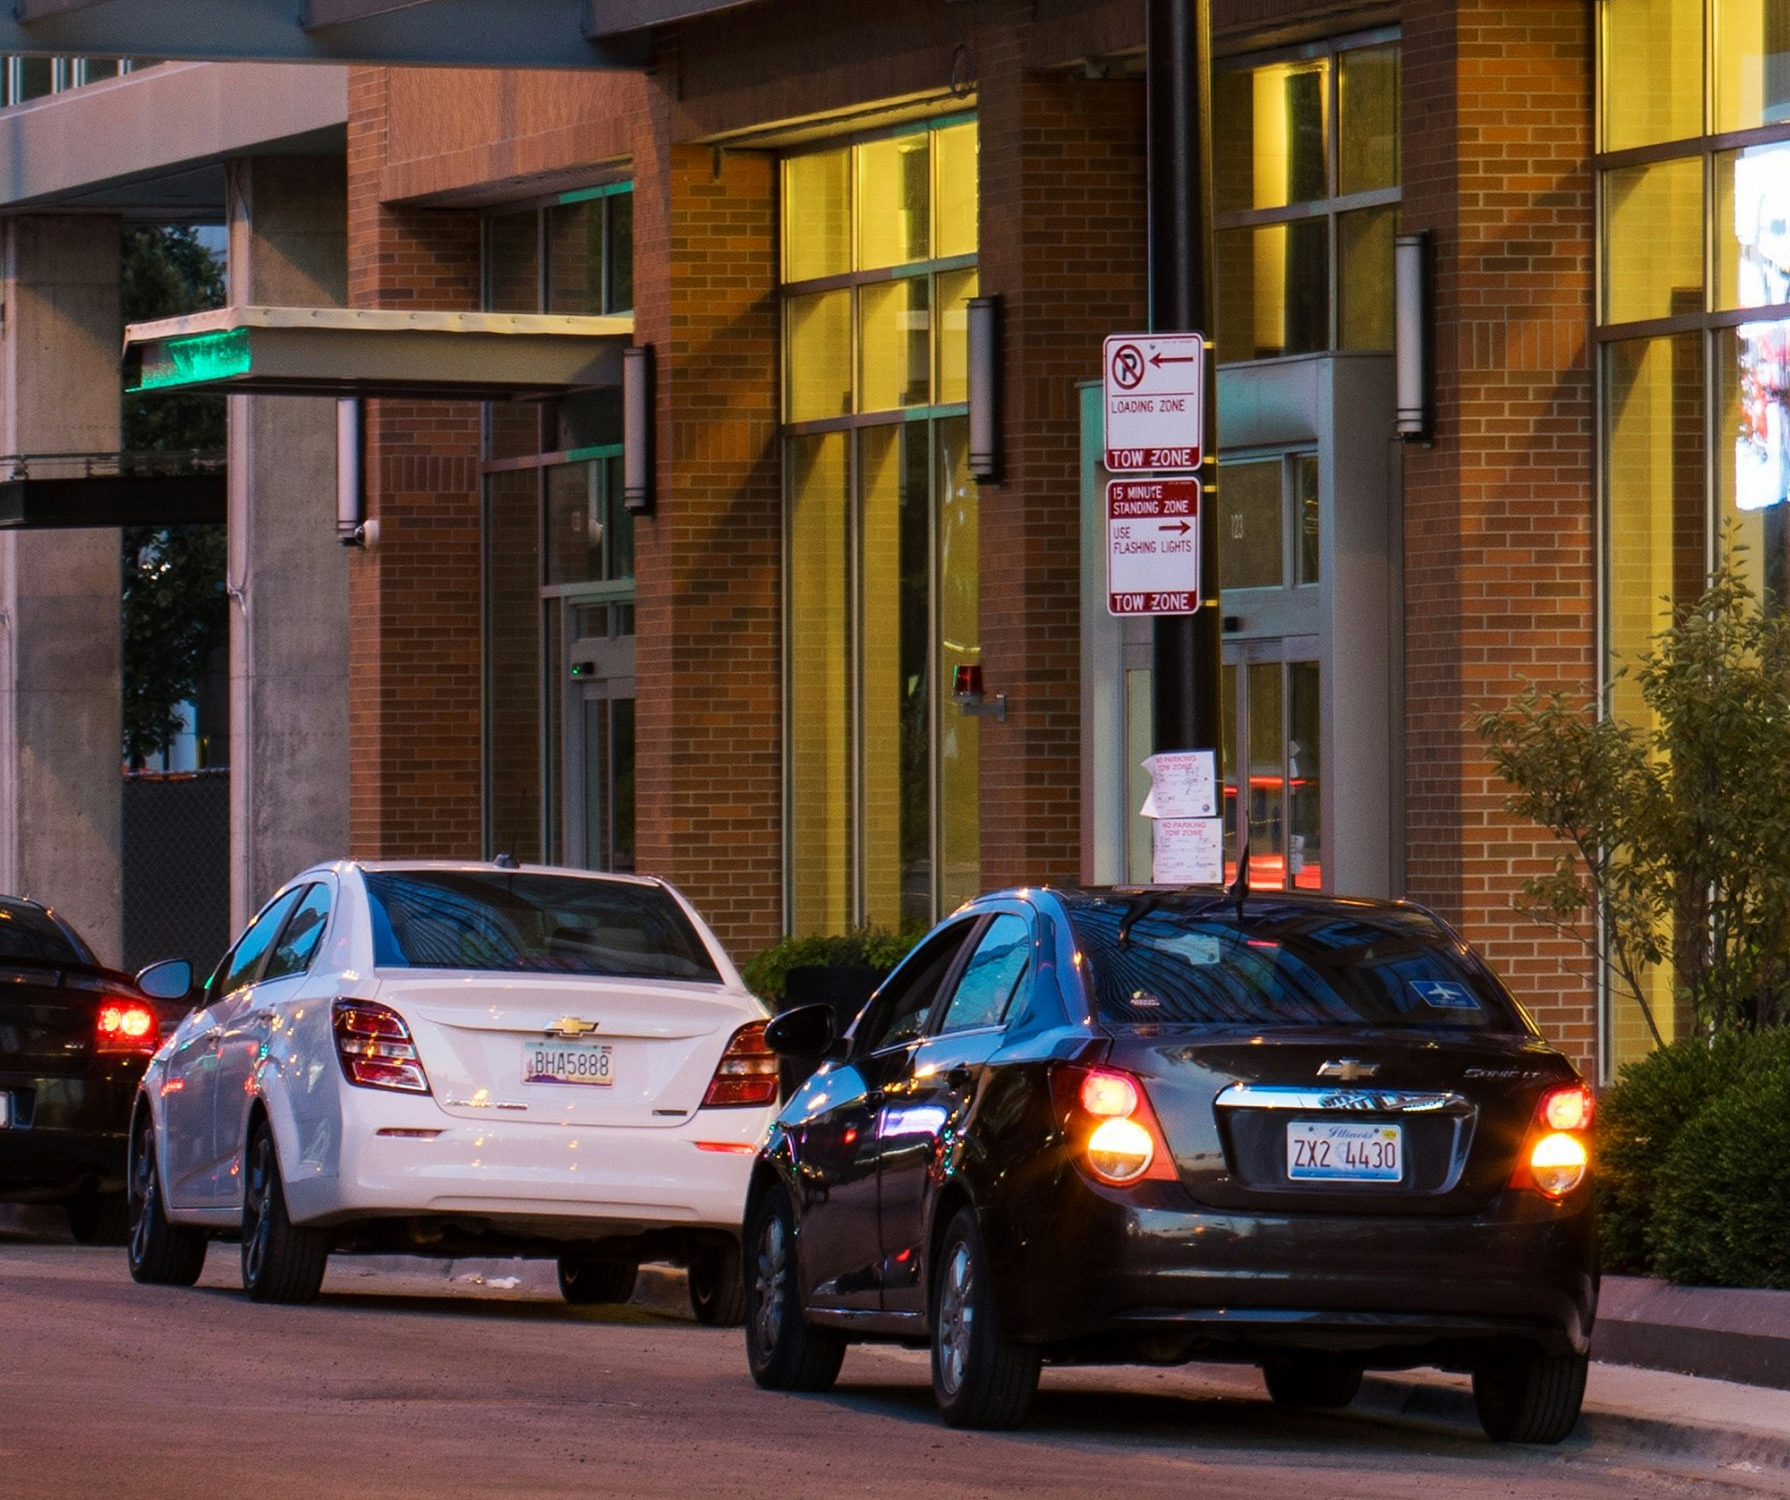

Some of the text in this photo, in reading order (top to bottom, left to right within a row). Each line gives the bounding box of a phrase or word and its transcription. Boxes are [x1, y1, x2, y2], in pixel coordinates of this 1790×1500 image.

[1111, 400, 1185, 413] LOADING ZONE
[1112, 449, 1191, 467] TOW ZONE
[1113, 485, 1162, 499] 15 MINUTE
[1113, 500, 1189, 515] STANDING ZONE
[1113, 527, 1131, 539] USE
[1113, 540, 1192, 555] FLASHING LIGHTS
[1114, 594, 1190, 611] TOW ZONE
[1162, 821, 1207, 829] NO PARKING
[1165, 829, 1203, 837] TOW ZONE
[535, 1051, 609, 1076] BHA5888
[1328, 1126, 1374, 1139] Illinois
[1294, 1140, 1397, 1169] ZX2 4430
